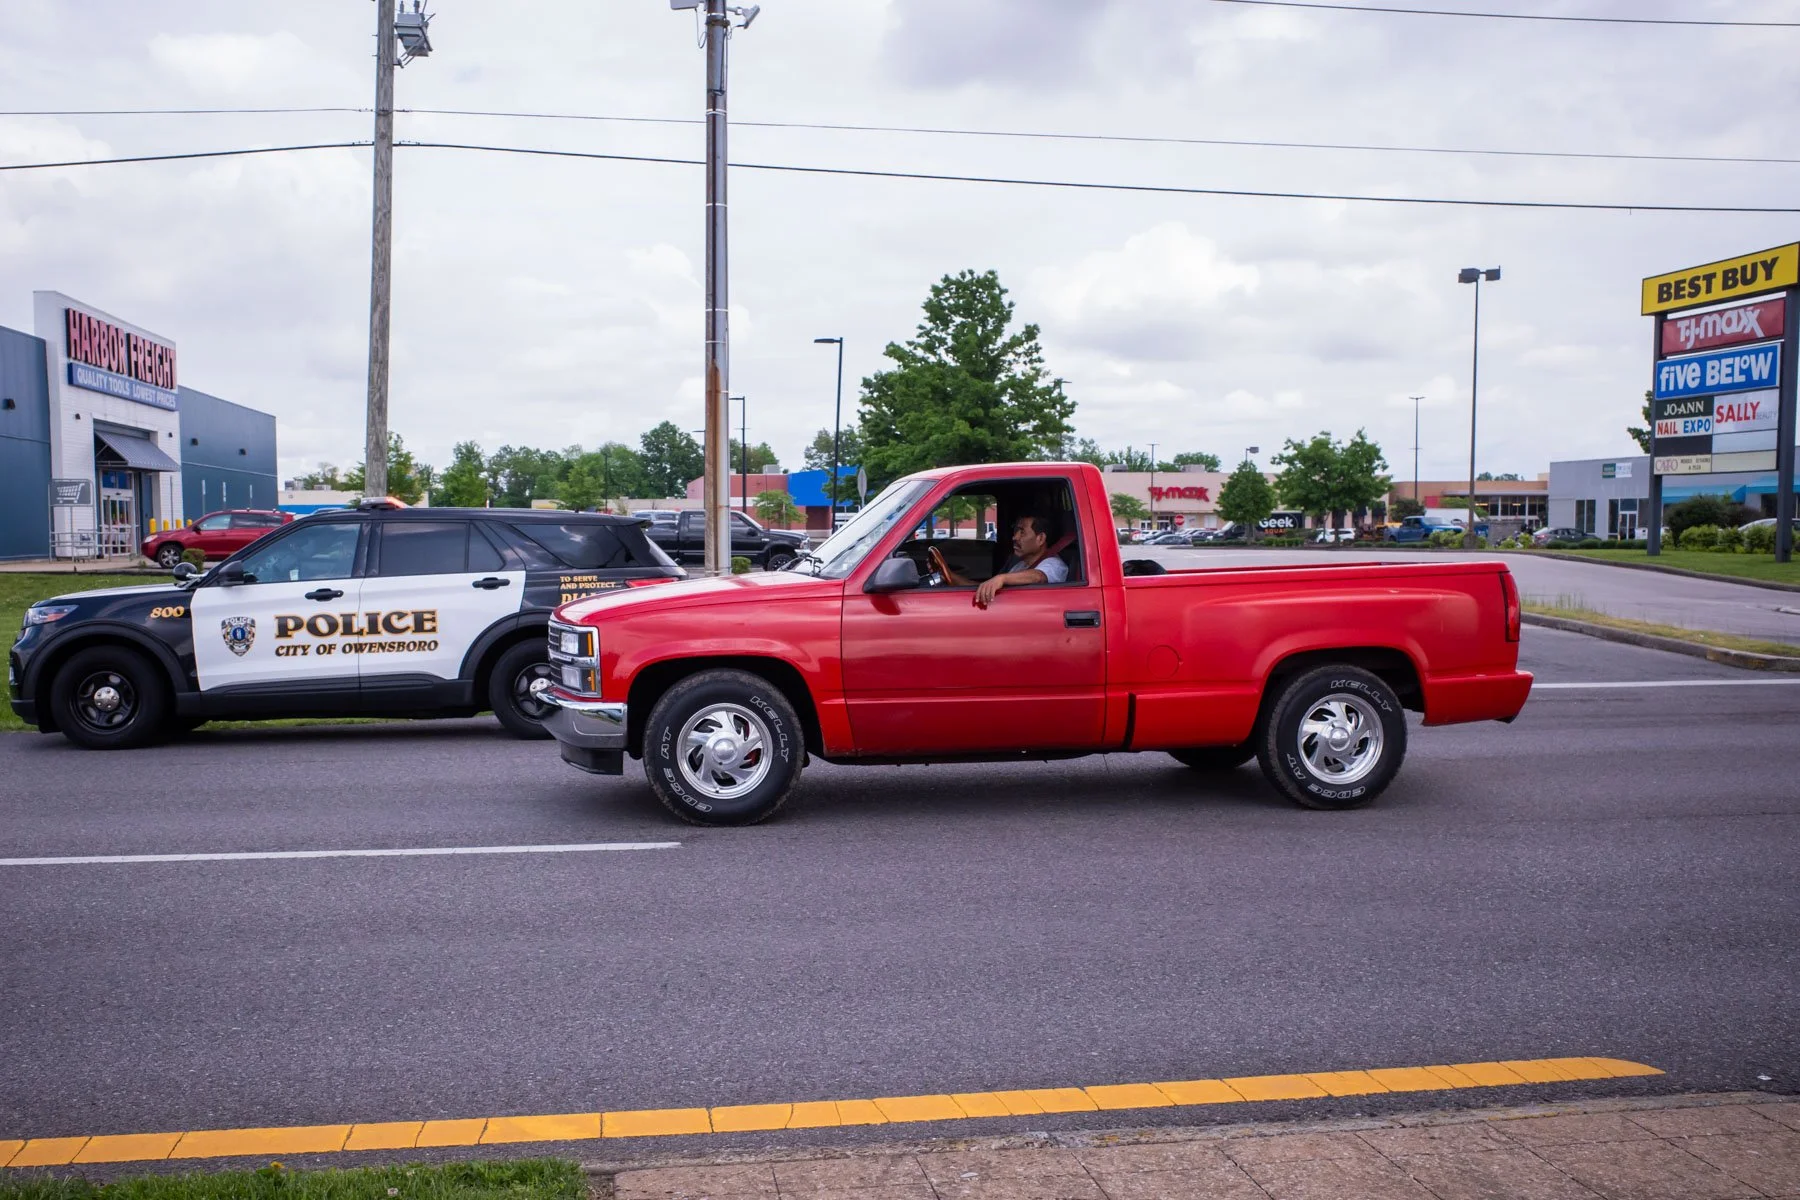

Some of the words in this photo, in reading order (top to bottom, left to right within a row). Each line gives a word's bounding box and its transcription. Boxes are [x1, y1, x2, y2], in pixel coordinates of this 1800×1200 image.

[1657, 271, 1717, 304] BEST
[1721, 256, 1780, 291] BUY
[66, 307, 127, 376] HARBOR
[127, 332, 176, 390] FREIGHT
[77, 367, 108, 389] QUALITY
[108, 376, 130, 395] TOOLS
[132, 383, 156, 402] LOWEST
[156, 391, 176, 409] PRICES
[1660, 361, 1701, 392] five
[1657, 421, 1678, 435] NAIL
[1683, 418, 1711, 433] EXPO
[1716, 401, 1760, 423] SALLY
[1259, 516, 1294, 528] Geek
[150, 605, 185, 618] 800
[274, 609, 438, 639] POLICE
[275, 644, 311, 657] CITY
[315, 643, 337, 656] OF
[341, 640, 439, 654] OWENSBORO
[1330, 679, 1393, 712] KELLY
[750, 695, 789, 763] KELLY
[663, 767, 713, 813] EDGE
[1307, 783, 1366, 799] EDGE
